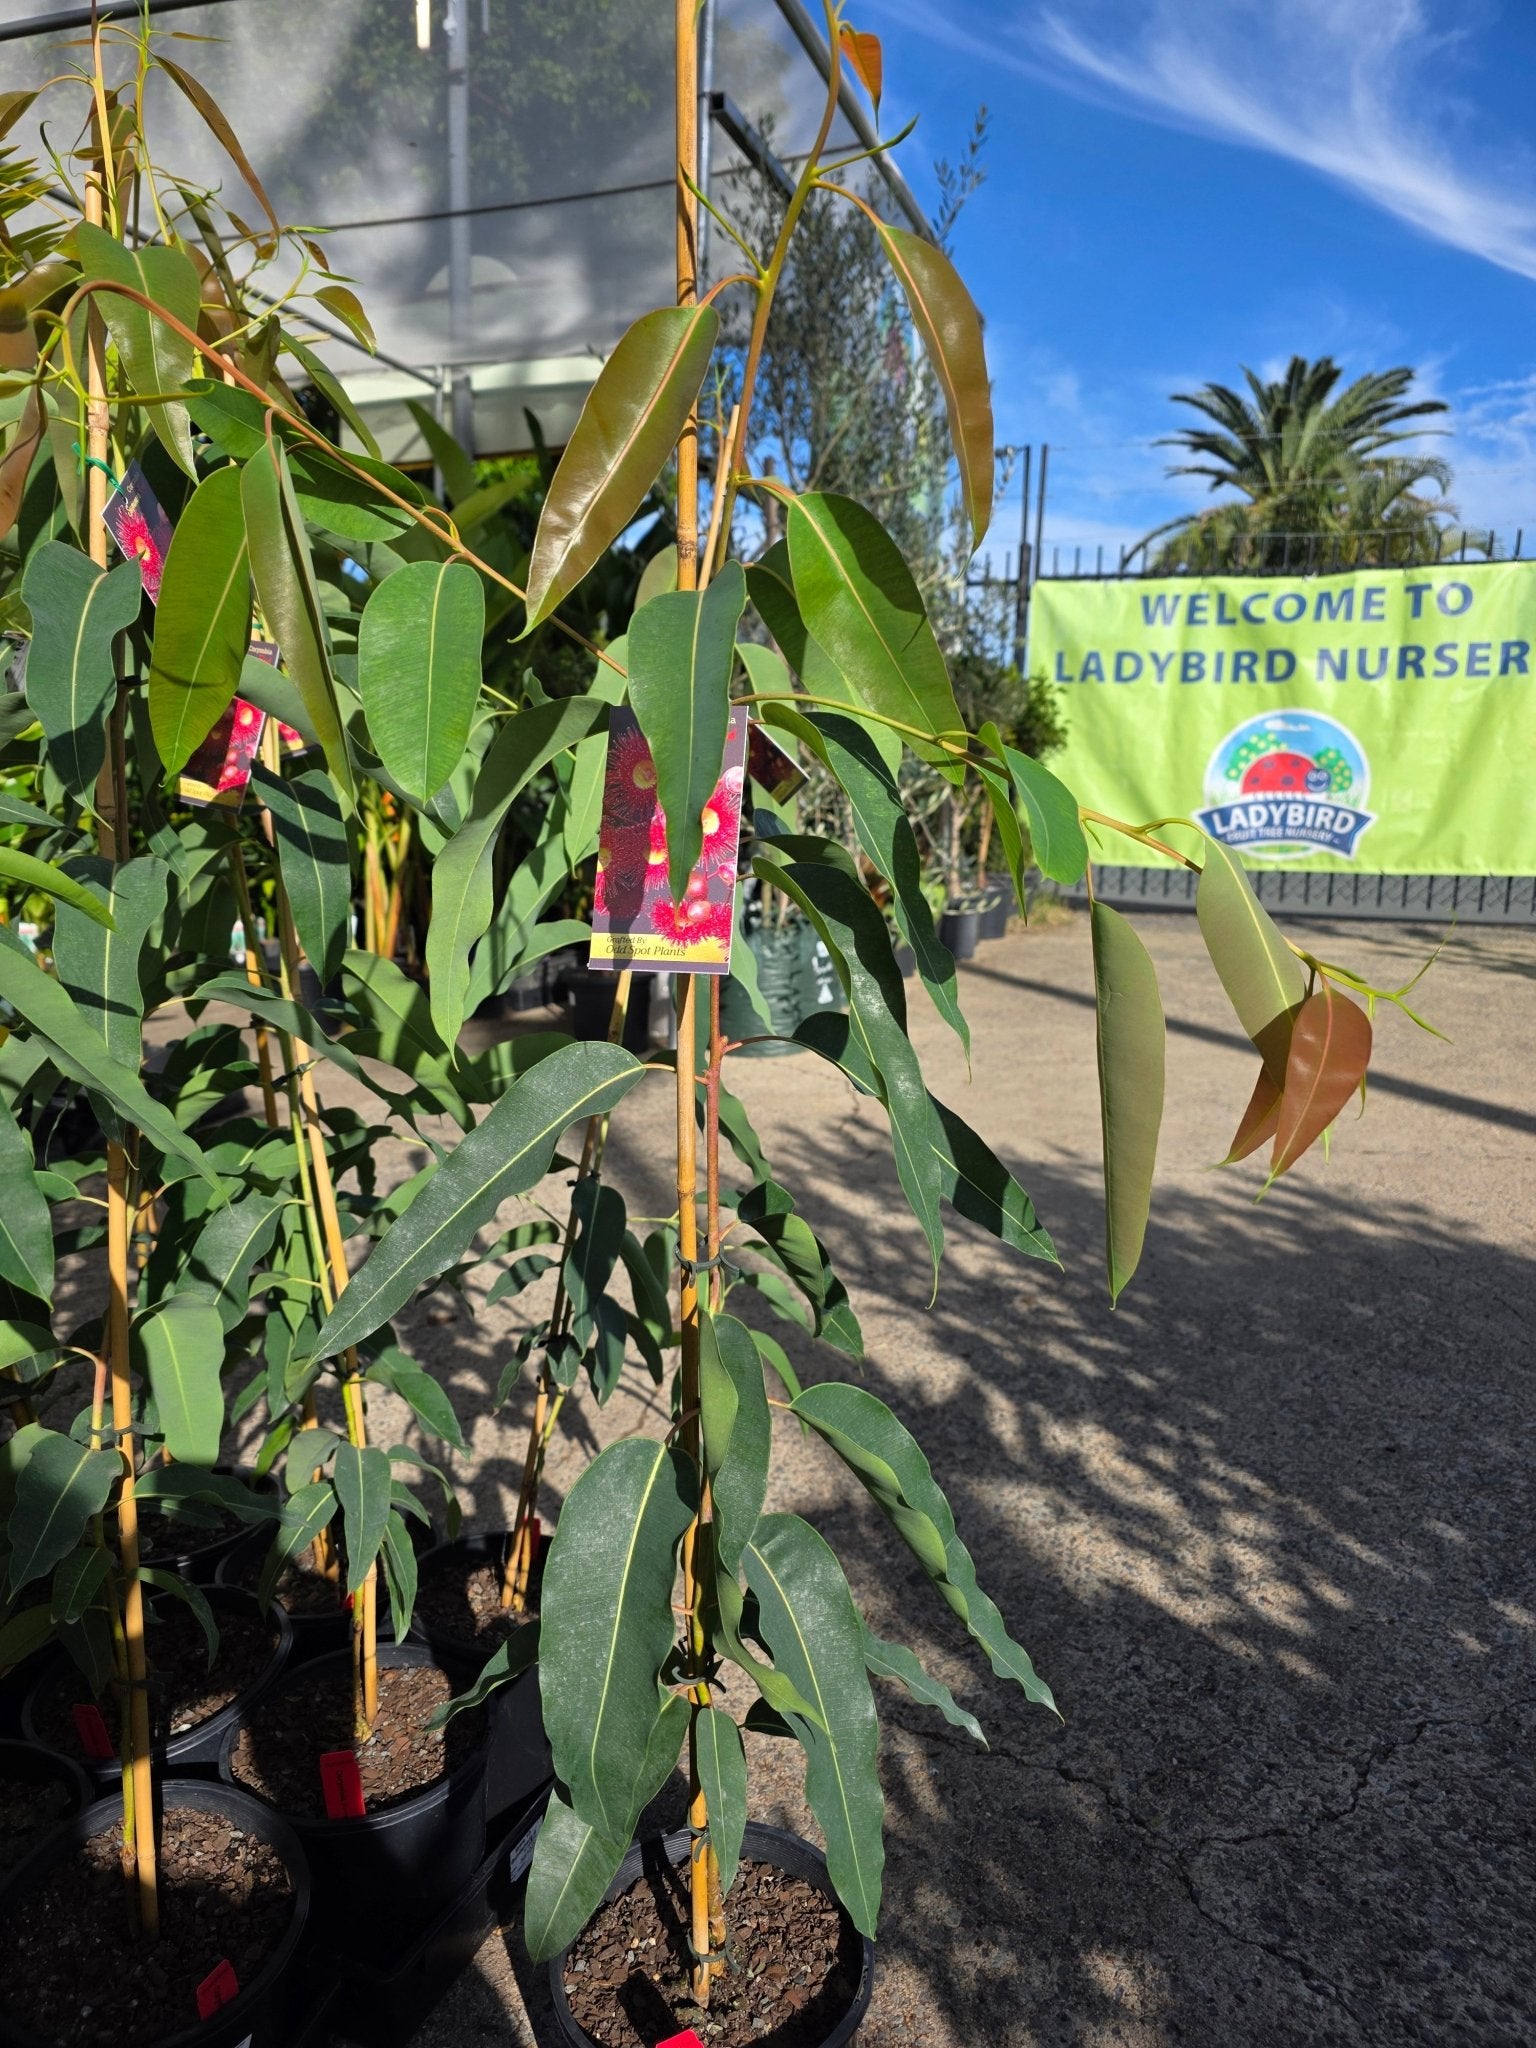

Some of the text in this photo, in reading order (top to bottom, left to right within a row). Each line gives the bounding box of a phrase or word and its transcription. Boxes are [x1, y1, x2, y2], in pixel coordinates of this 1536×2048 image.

[1141, 582, 1474, 627] WELCOME TO
[1055, 648, 1297, 684] LADYBIRD
[1211, 802, 1356, 834] LADYBIRD
[605, 944, 686, 957] Odd Spot Plants
[606, 935, 648, 945] Grafted By
